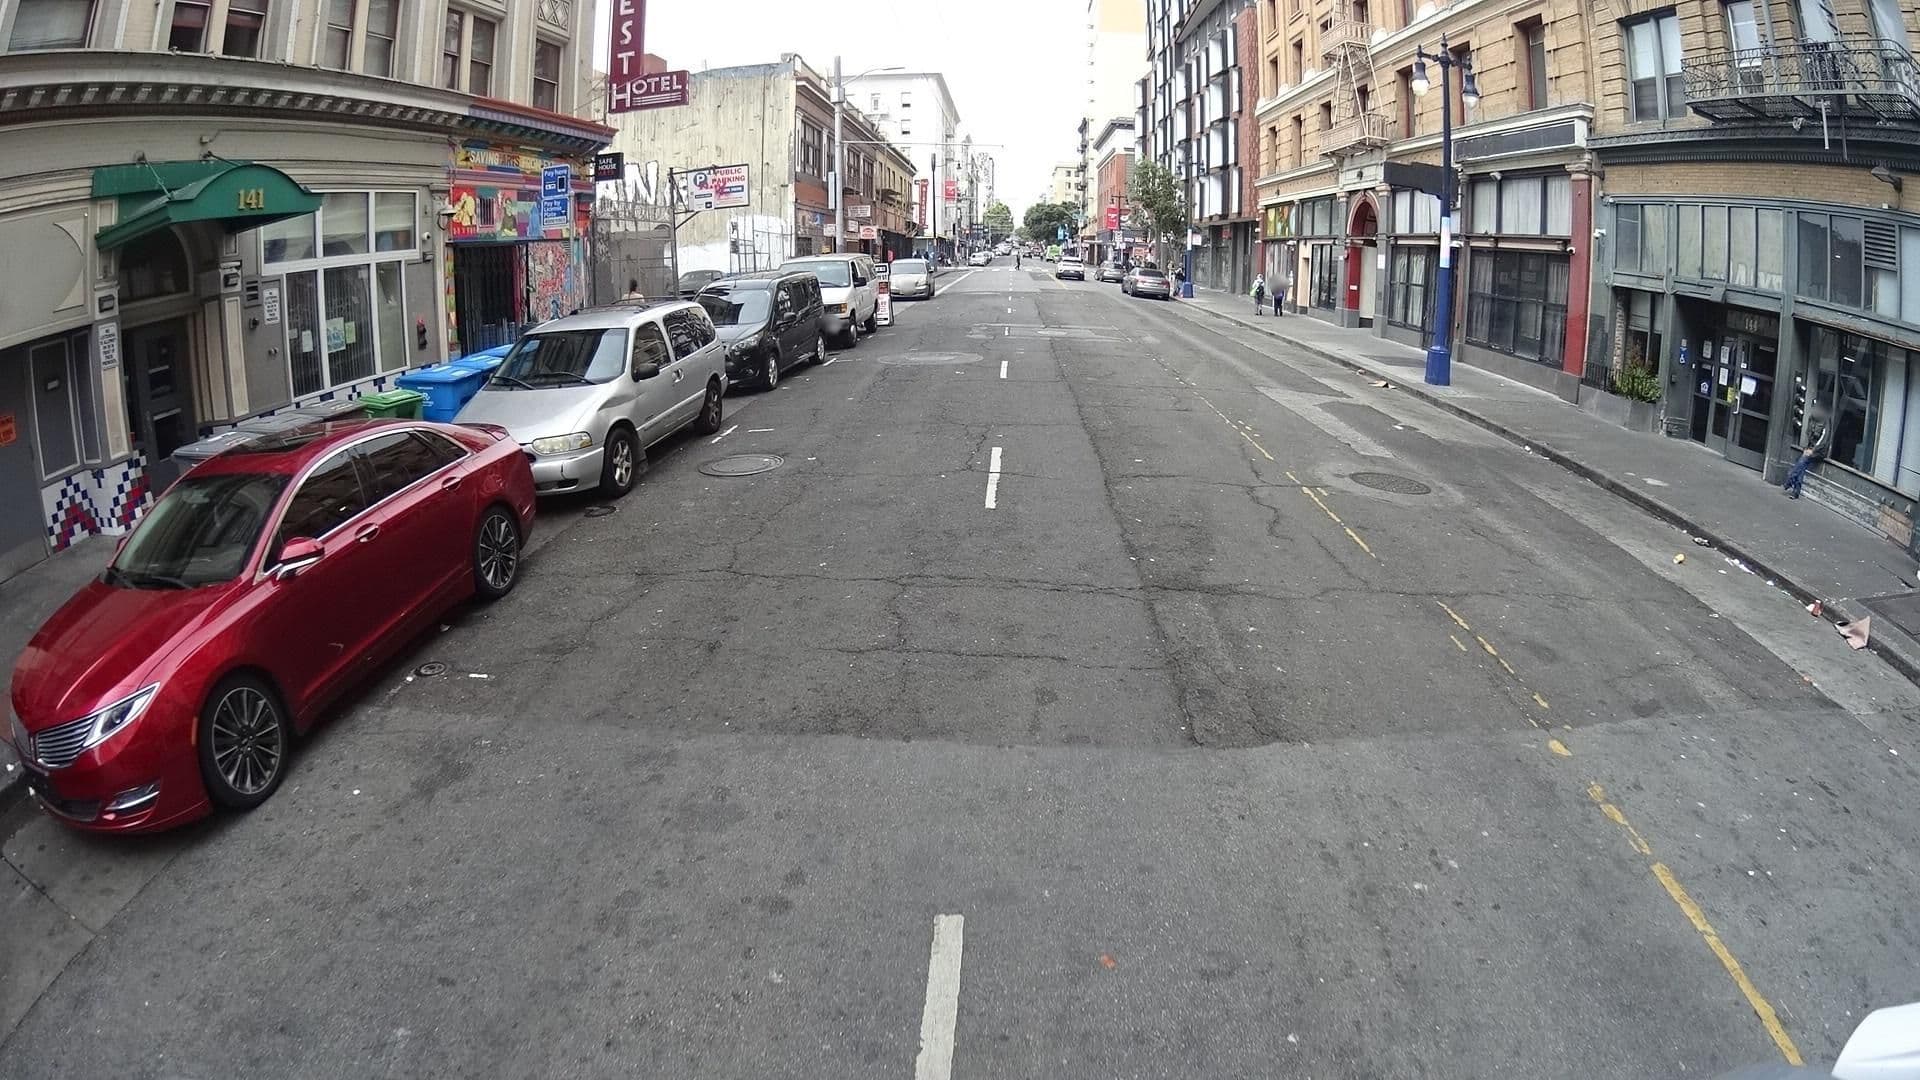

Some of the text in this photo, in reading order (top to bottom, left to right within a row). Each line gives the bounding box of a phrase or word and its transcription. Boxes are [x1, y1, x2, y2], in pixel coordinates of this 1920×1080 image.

[611, 75, 682, 109] HOTEL
[470, 150, 499, 166] SAVING
[599, 157, 613, 165] SAFE
[599, 163, 617, 171] HOUSE
[715, 167, 742, 177] PUBLIC
[544, 170, 554, 178] Pay
[238, 188, 265, 210] 141
